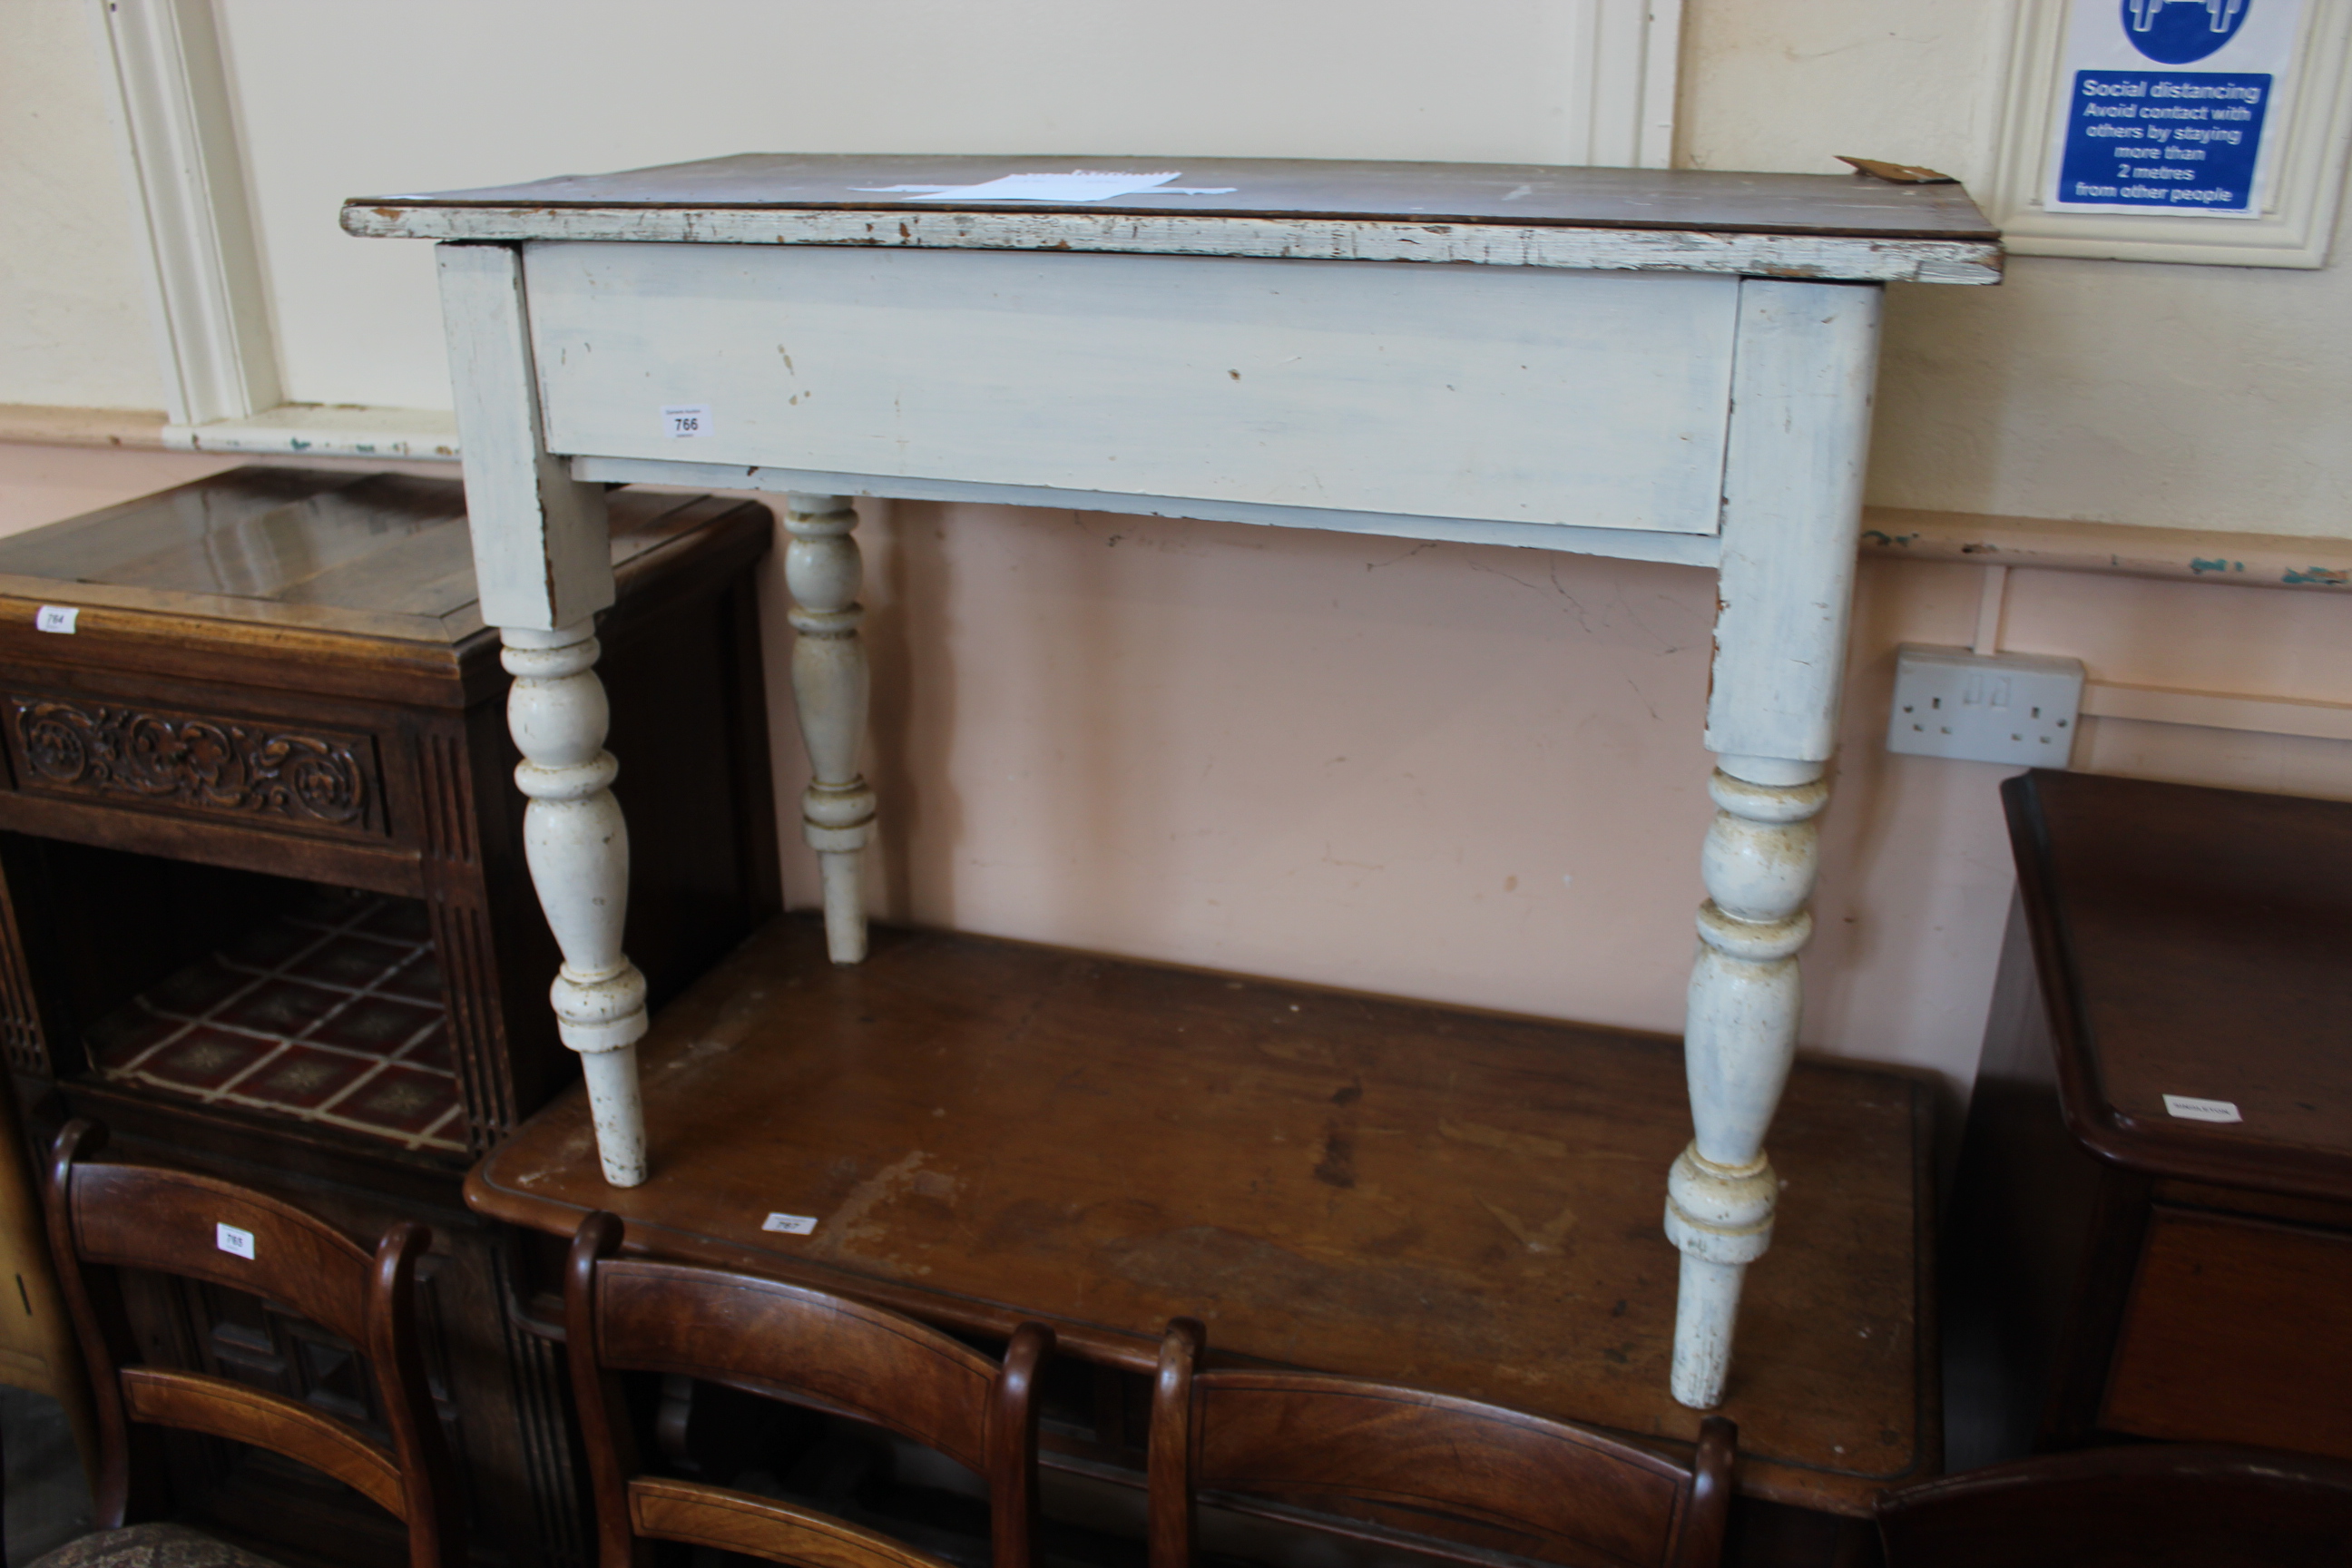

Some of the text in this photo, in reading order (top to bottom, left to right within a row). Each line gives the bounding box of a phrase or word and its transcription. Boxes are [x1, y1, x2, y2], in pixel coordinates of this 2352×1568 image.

[2082, 79, 2261, 104] Social distancing
[2082, 103, 2252, 122] Avoid contact with
[2085, 123, 2243, 145] others by staying
[2113, 146, 2206, 161] more than
[2116, 163, 2196, 181] 2 metres
[2075, 182, 2234, 204] from other people
[674, 417, 699, 431] 766
